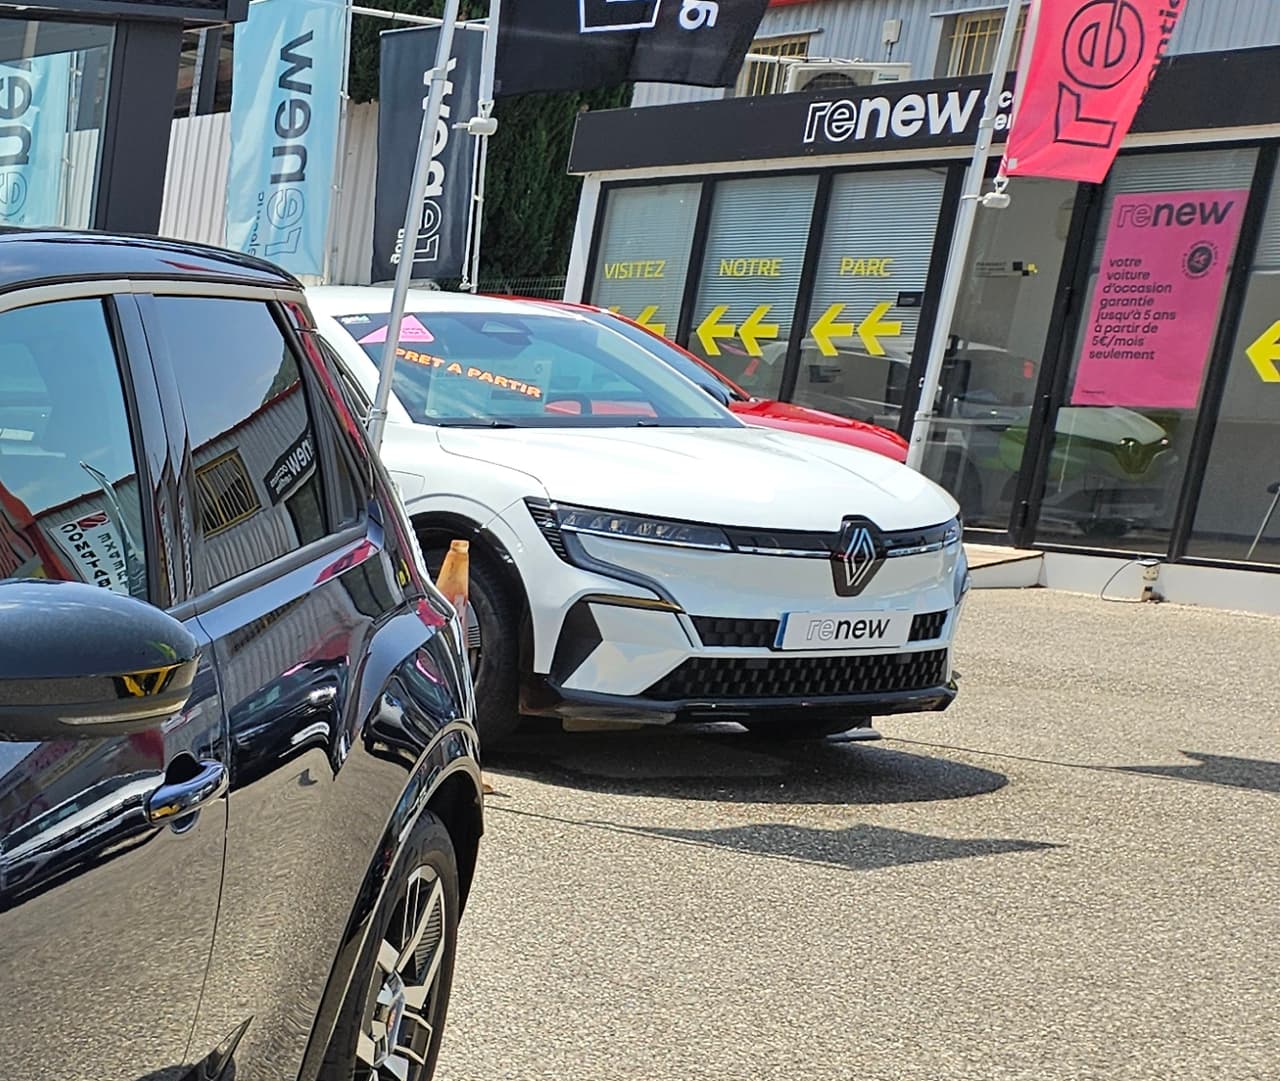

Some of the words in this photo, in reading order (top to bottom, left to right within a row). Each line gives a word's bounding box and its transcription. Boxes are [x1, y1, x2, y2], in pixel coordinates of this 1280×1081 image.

[803, 89, 981, 143] renew
[1117, 200, 1234, 228] renew
[604, 260, 666, 279] VISITEZ
[719, 258, 784, 277] NOTRE
[840, 257, 895, 277] PARC
[1109, 257, 1142, 268] votre
[1107, 270, 1150, 281] voiture
[1103, 283, 1172, 294] d'occasion
[1100, 296, 1154, 310] garantie
[1096, 310, 1140, 323] jusqu'à
[1144, 310, 1151, 320] 5
[1153, 311, 1176, 320] ans
[1104, 323, 1140, 335] partir
[1142, 323, 1158, 333] de
[1092, 335, 1144, 347] 5€/mois
[1089, 350, 1155, 360] seulement
[395, 348, 445, 368] PRET
[447, 362, 462, 375] A
[467, 367, 542, 398] PARTIR
[807, 619, 891, 641] renew
